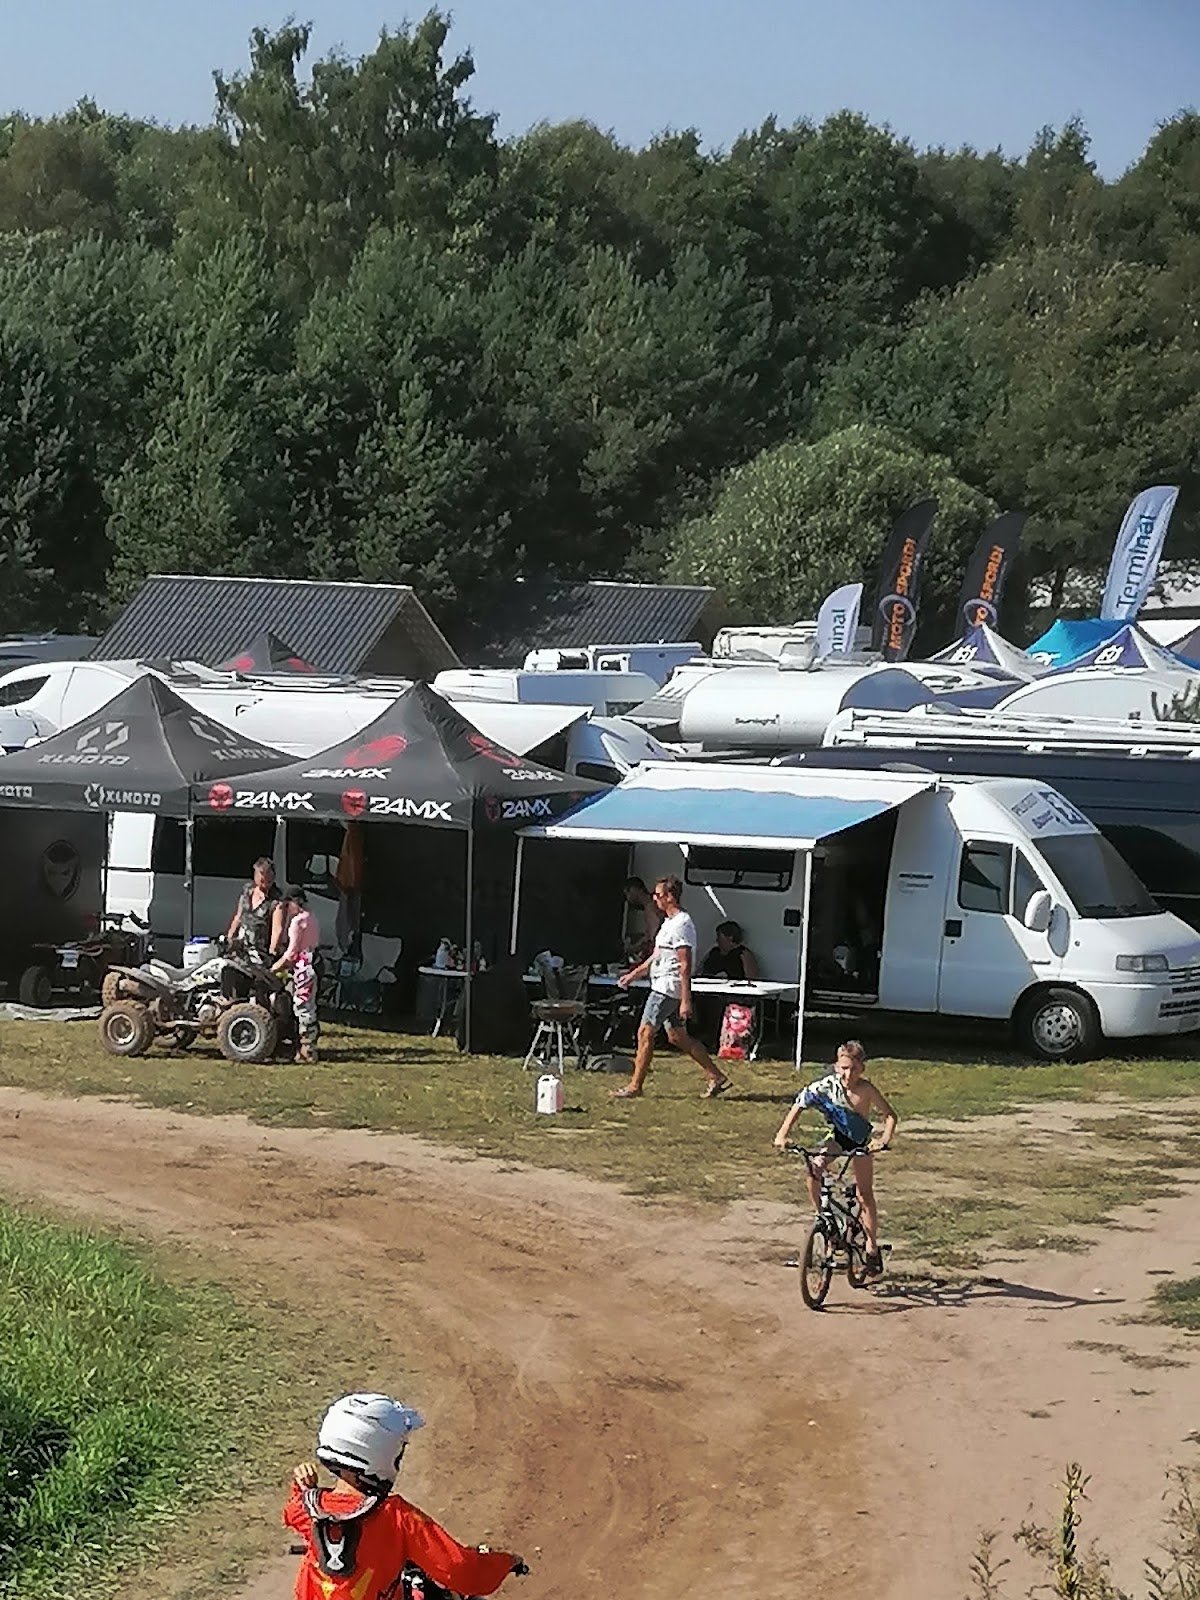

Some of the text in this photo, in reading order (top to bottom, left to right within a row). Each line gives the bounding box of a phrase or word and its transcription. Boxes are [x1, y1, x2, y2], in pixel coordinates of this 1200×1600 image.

[1116, 514, 1157, 609] Terminal
[888, 602, 905, 650] MOTO
[106, 790, 162, 806] XLMOTO
[234, 791, 315, 812] 24MX
[369, 796, 452, 821] 24MX
[502, 798, 552, 819] 24MX
